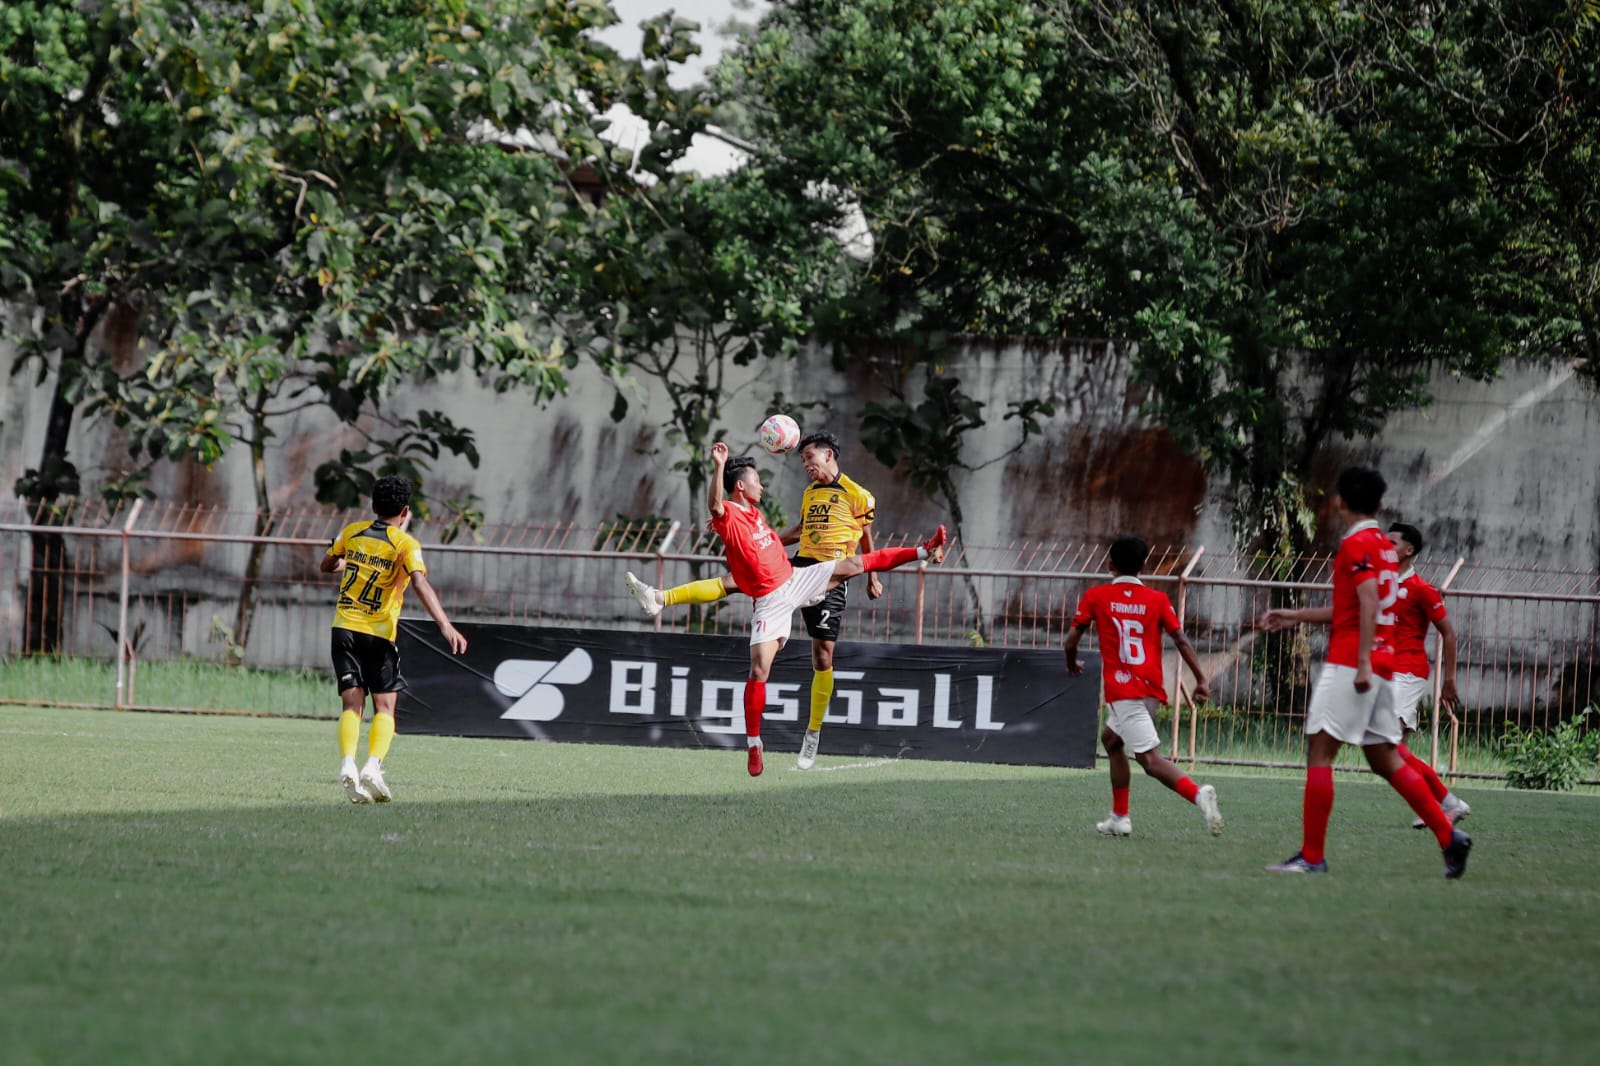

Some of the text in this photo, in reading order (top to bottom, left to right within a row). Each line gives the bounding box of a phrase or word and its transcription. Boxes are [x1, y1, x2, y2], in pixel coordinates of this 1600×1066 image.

[340, 562, 383, 611] 24
[819, 609, 831, 628] 2
[1110, 601, 1146, 615] FIRMAN
[1112, 616, 1146, 666] 16
